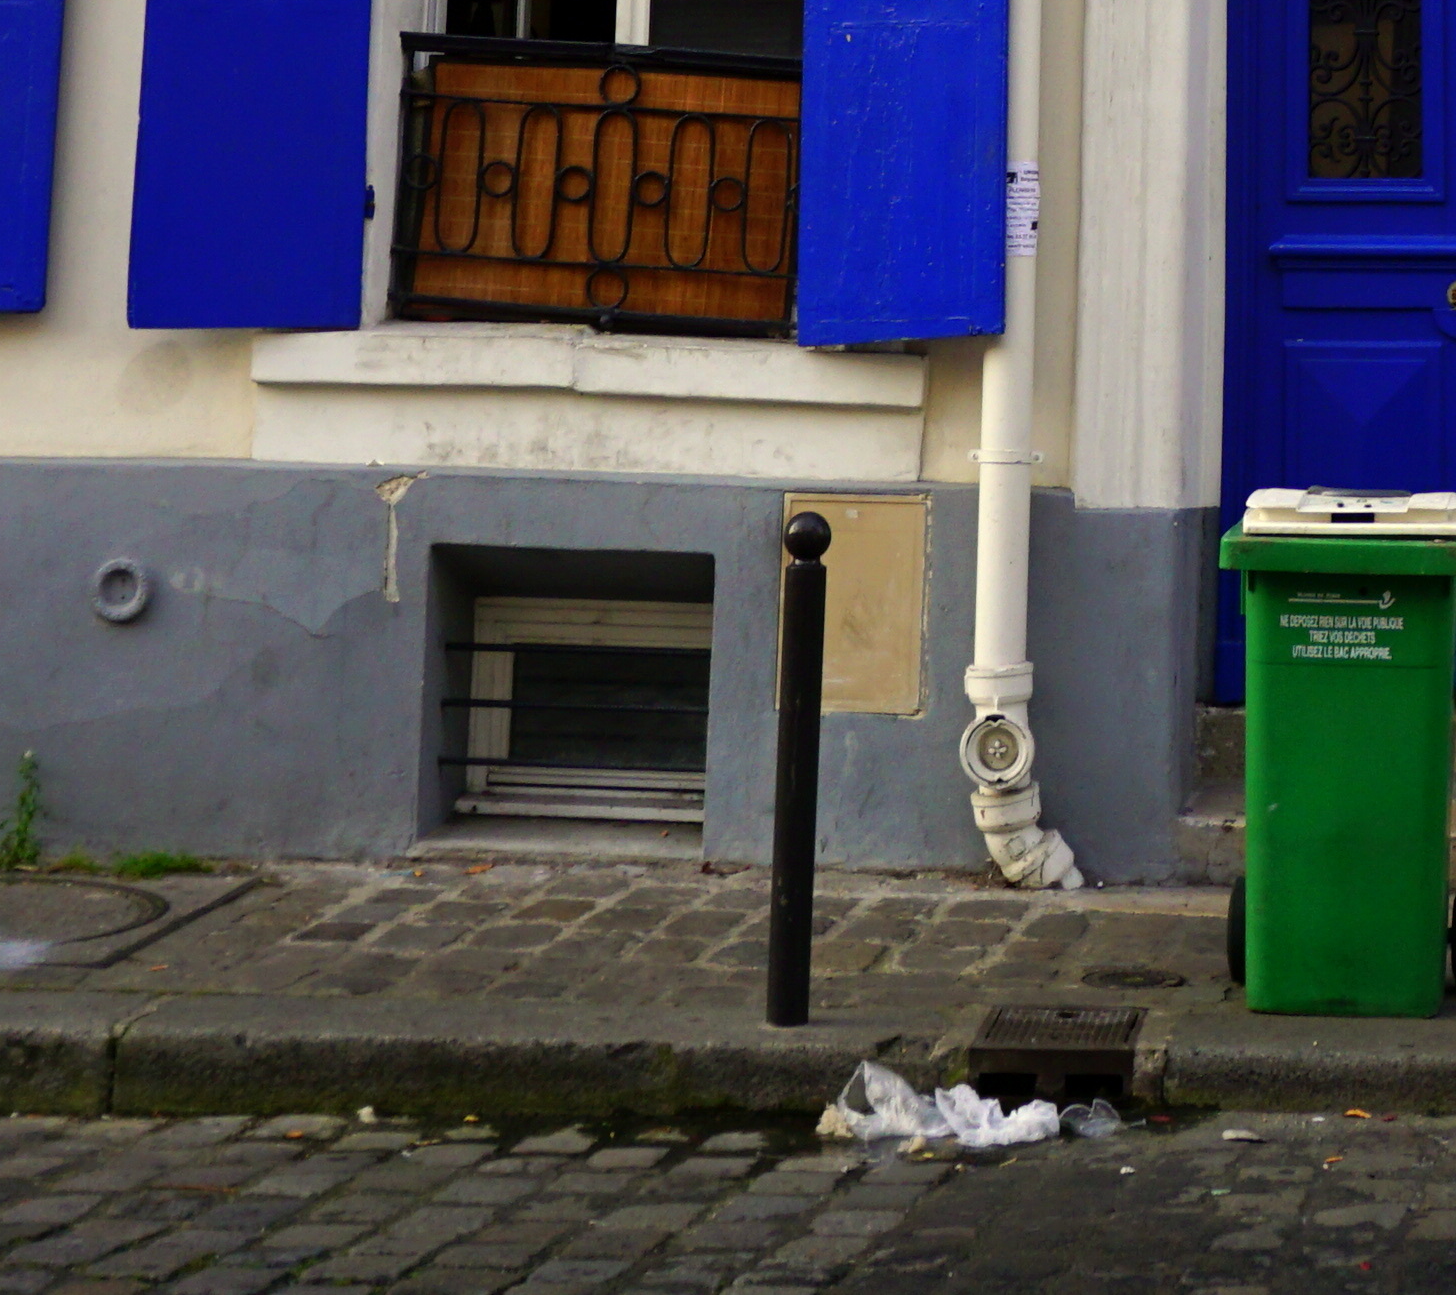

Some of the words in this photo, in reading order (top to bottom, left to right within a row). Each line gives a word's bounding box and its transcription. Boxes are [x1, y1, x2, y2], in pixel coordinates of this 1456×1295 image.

[1280, 614, 1289, 628] NE
[1348, 616, 1357, 629] LA
[1373, 617, 1404, 630] PUBLIQUE
[1309, 630, 1328, 643] TRIEZ
[1329, 631, 1343, 644] VOS
[1292, 645, 1323, 658] UTILISEZ
[1324, 646, 1333, 658] LE
[1334, 646, 1350, 659] BAC
